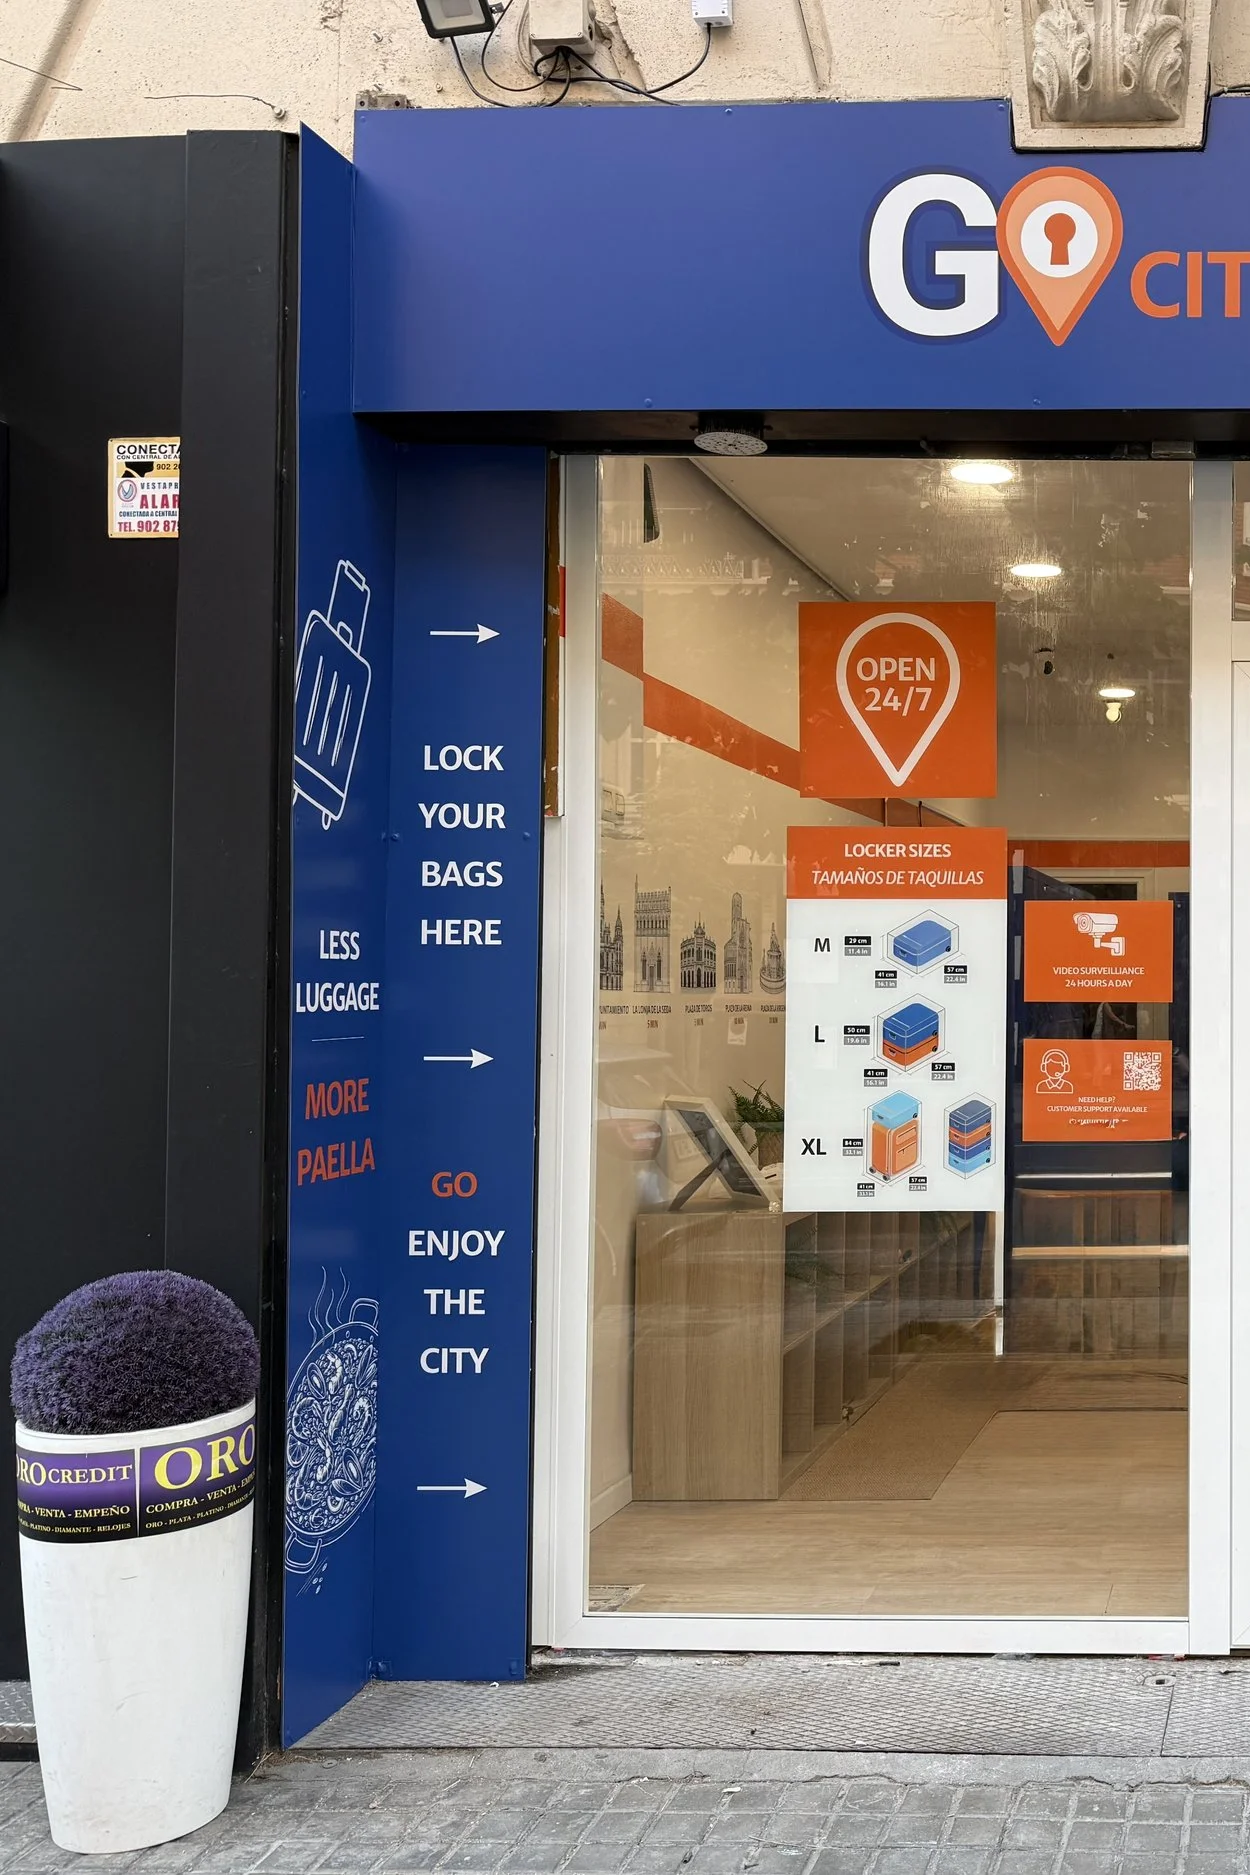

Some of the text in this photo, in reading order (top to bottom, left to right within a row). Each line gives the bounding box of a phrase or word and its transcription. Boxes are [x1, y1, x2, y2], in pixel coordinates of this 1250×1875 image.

[118, 520, 179, 533] TEL. 902 87
[857, 657, 936, 682] OPEN
[864, 687, 932, 716] 24/7
[423, 745, 505, 772] LOCK
[418, 803, 506, 830] YOUR
[844, 843, 951, 858] LOCKER SIZES
[421, 861, 504, 888] BAGS
[812, 867, 984, 886] TAMAÑOS DE TAQUILLAS
[319, 929, 361, 960] LESS
[420, 918, 503, 946] HERE
[814, 938, 830, 952] M
[1053, 967, 1145, 975] VIDEO SURVEILLIANCE
[1065, 979, 1133, 987] 24 HOURS A DAY
[296, 981, 380, 1014] LUGGAGE
[814, 1025, 826, 1043] L
[305, 1077, 371, 1120] MORE
[801, 1138, 826, 1155] XL
[297, 1138, 375, 1186] PAELLA
[431, 1171, 478, 1198] GO
[408, 1230, 505, 1258] ENJOY
[424, 1288, 486, 1315] THE
[419, 1347, 489, 1375] CITY
[16, 1453, 133, 1486] ROCREDIT
[154, 1424, 256, 1490] ORO
[35, 1505, 130, 1519] VENTA EMPEÑO
[146, 1497, 198, 1514] COMPRA
[206, 1484, 236, 1500] VENTA
[97, 1522, 131, 1532] RELOJES
[145, 1520, 163, 1529] ORO
[169, 1515, 192, 1525] PLATA
[197, 1505, 224, 1519] PLATINO
